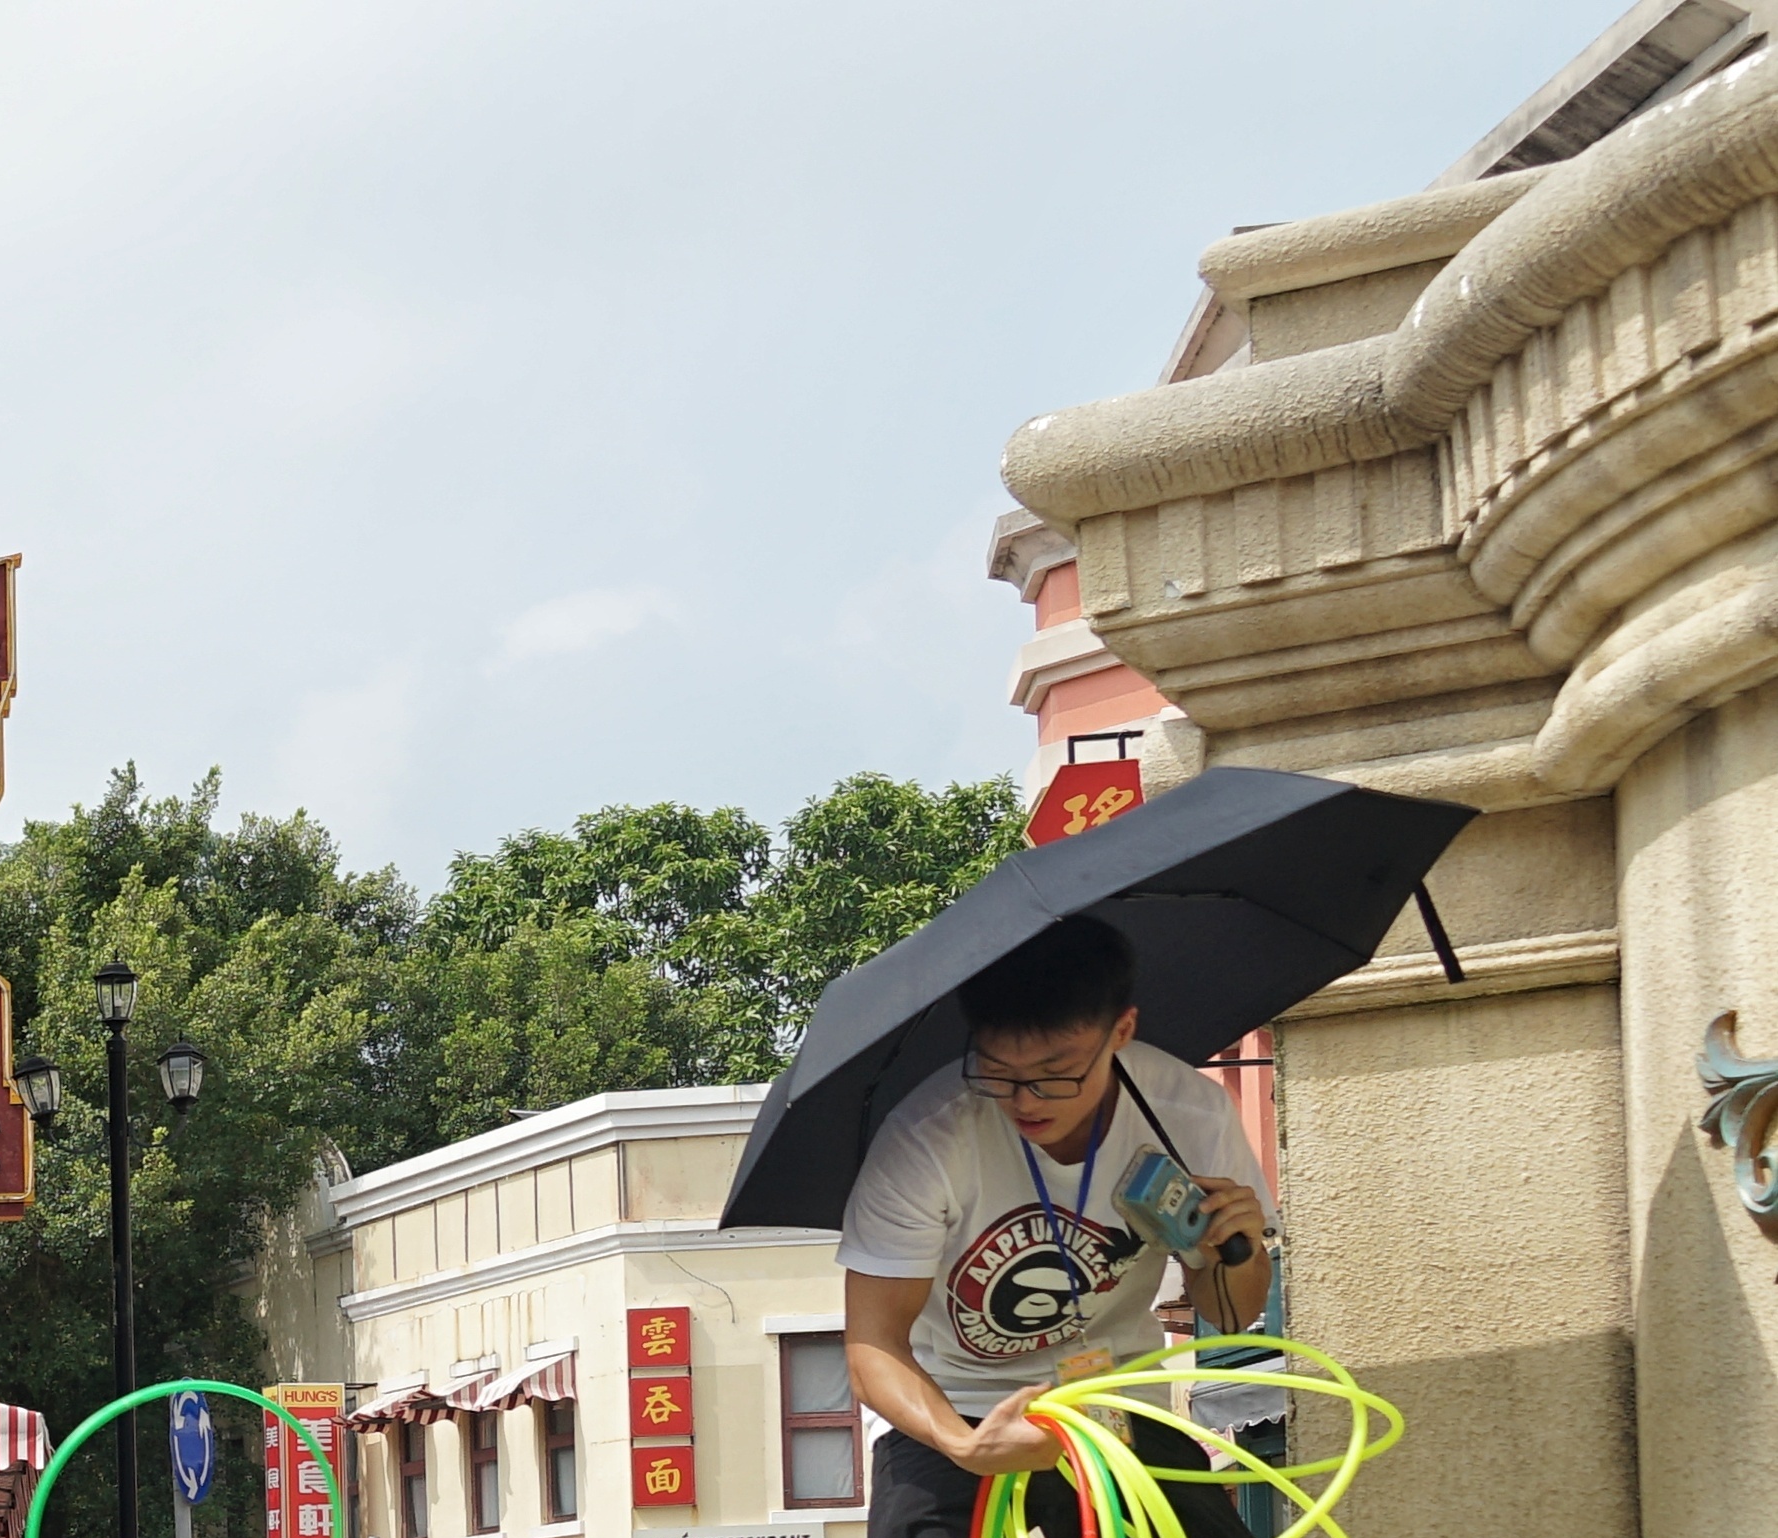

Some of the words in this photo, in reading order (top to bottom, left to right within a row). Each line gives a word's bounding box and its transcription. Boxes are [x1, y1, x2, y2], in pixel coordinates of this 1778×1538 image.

[966, 1222, 1029, 1285] AAPE
[958, 1312, 1040, 1354] DRAGON
[284, 1390, 339, 1403] HUNG'S
[641, 1317, 682, 1495] 雲吞面
